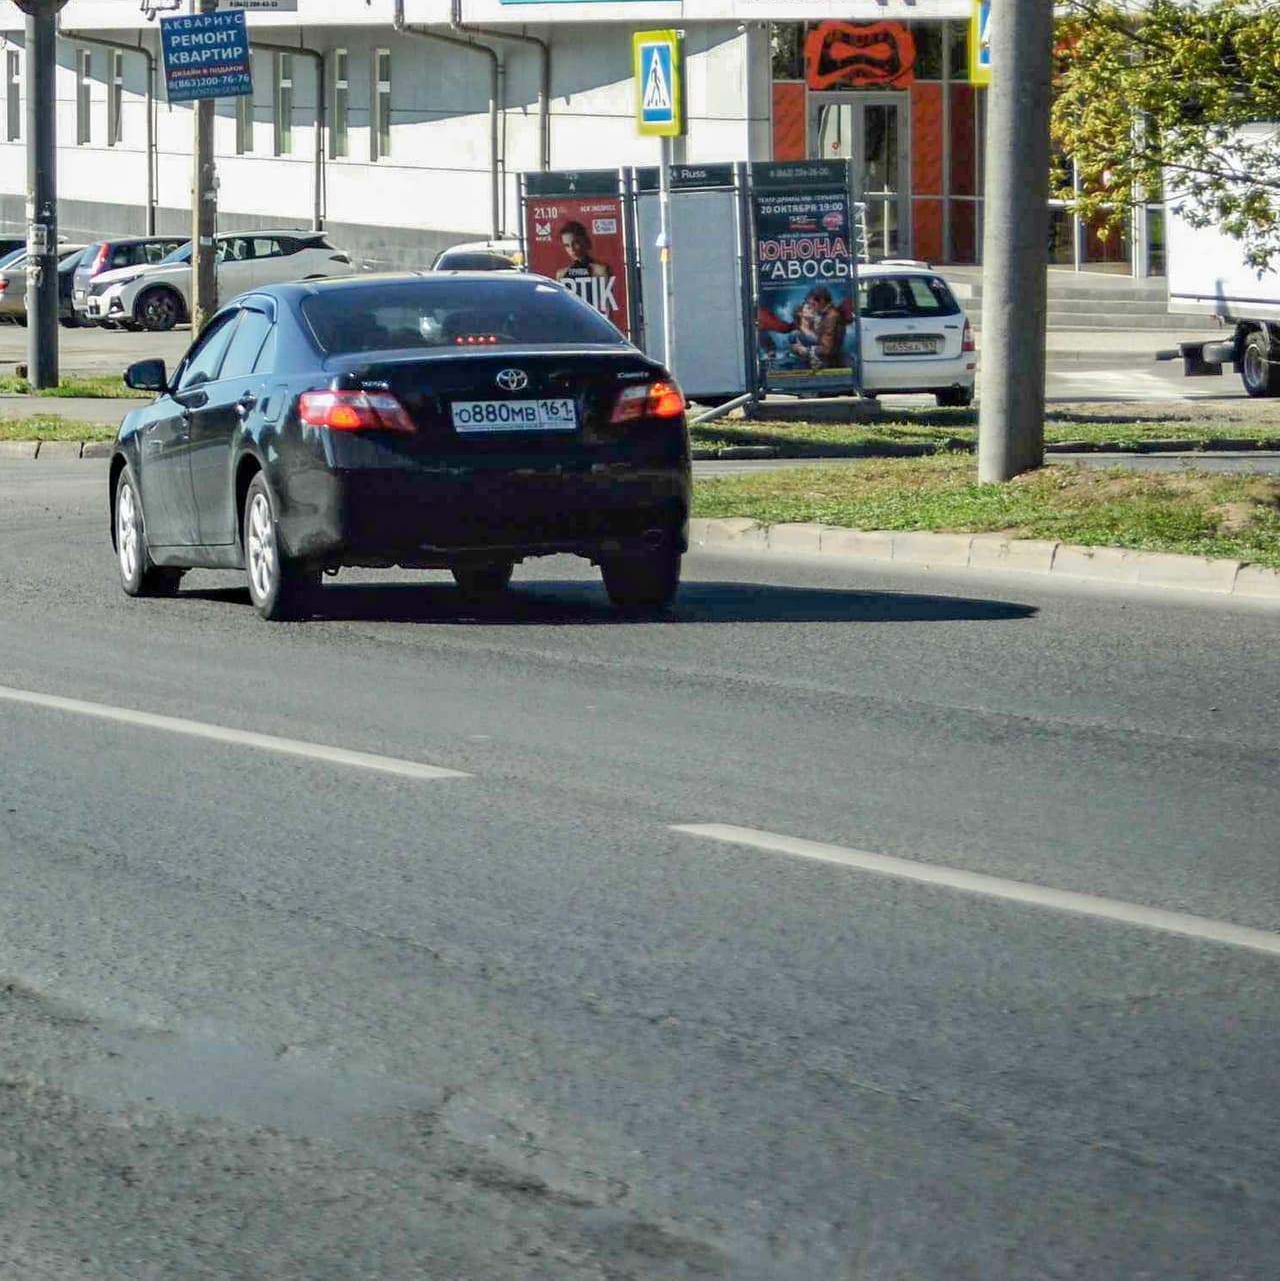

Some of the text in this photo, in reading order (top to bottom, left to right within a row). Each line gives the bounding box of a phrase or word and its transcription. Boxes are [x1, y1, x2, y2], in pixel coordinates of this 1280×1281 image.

[163, 13, 244, 31] АКВАРИУС
[170, 29, 238, 48] РЕМОНТ
[168, 46, 243, 65] КВАРТИР
[680, 169, 707, 180] Russ
[533, 206, 559, 220] 21.10
[760, 202, 844, 215] 20 ОКТЯБРЯ 19:00
[759, 237, 849, 261] ЮНОНА
[458, 400, 570, 424] О880МВ 161
